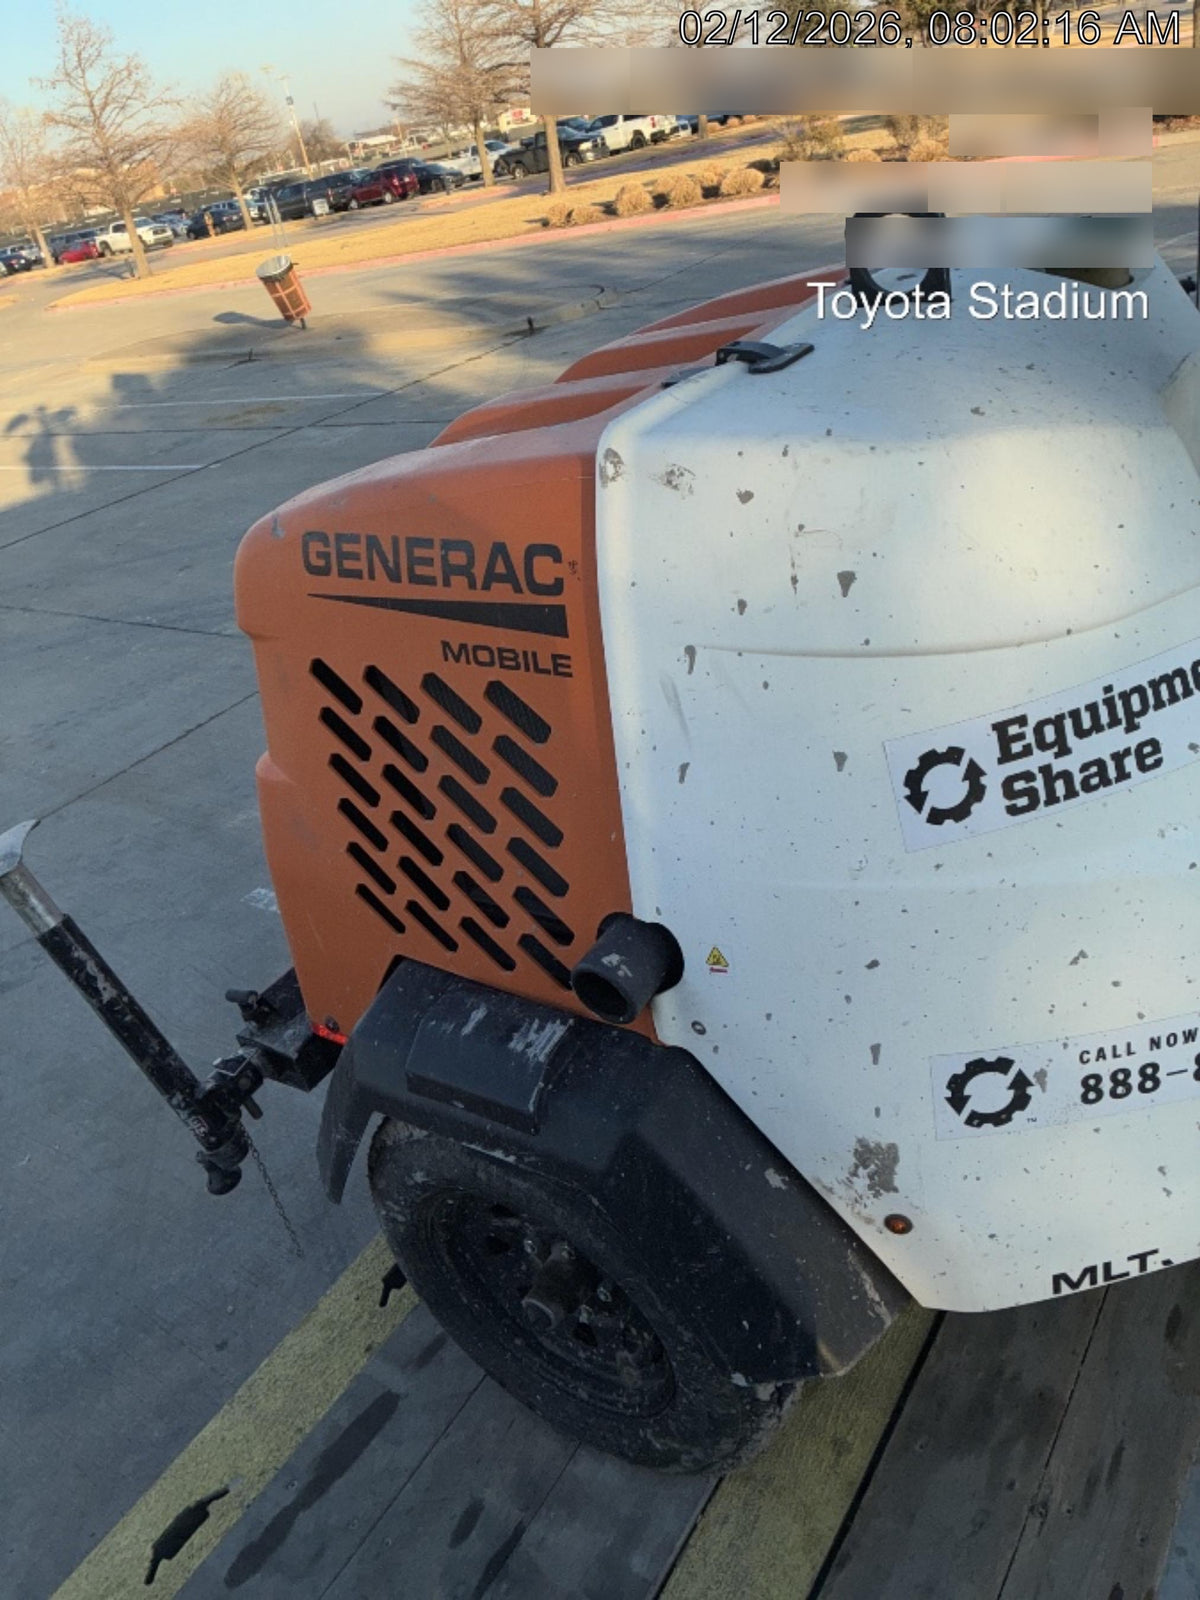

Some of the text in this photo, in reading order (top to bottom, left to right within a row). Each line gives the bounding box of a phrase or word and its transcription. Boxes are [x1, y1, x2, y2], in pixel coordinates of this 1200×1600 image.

[302, 531, 565, 596] GENERAC
[441, 640, 574, 678] MOBILE
[1001, 737, 1164, 817] Share
[1079, 1027, 1199, 1065] CALL NOW
[1052, 1248, 1174, 1294] MLT
